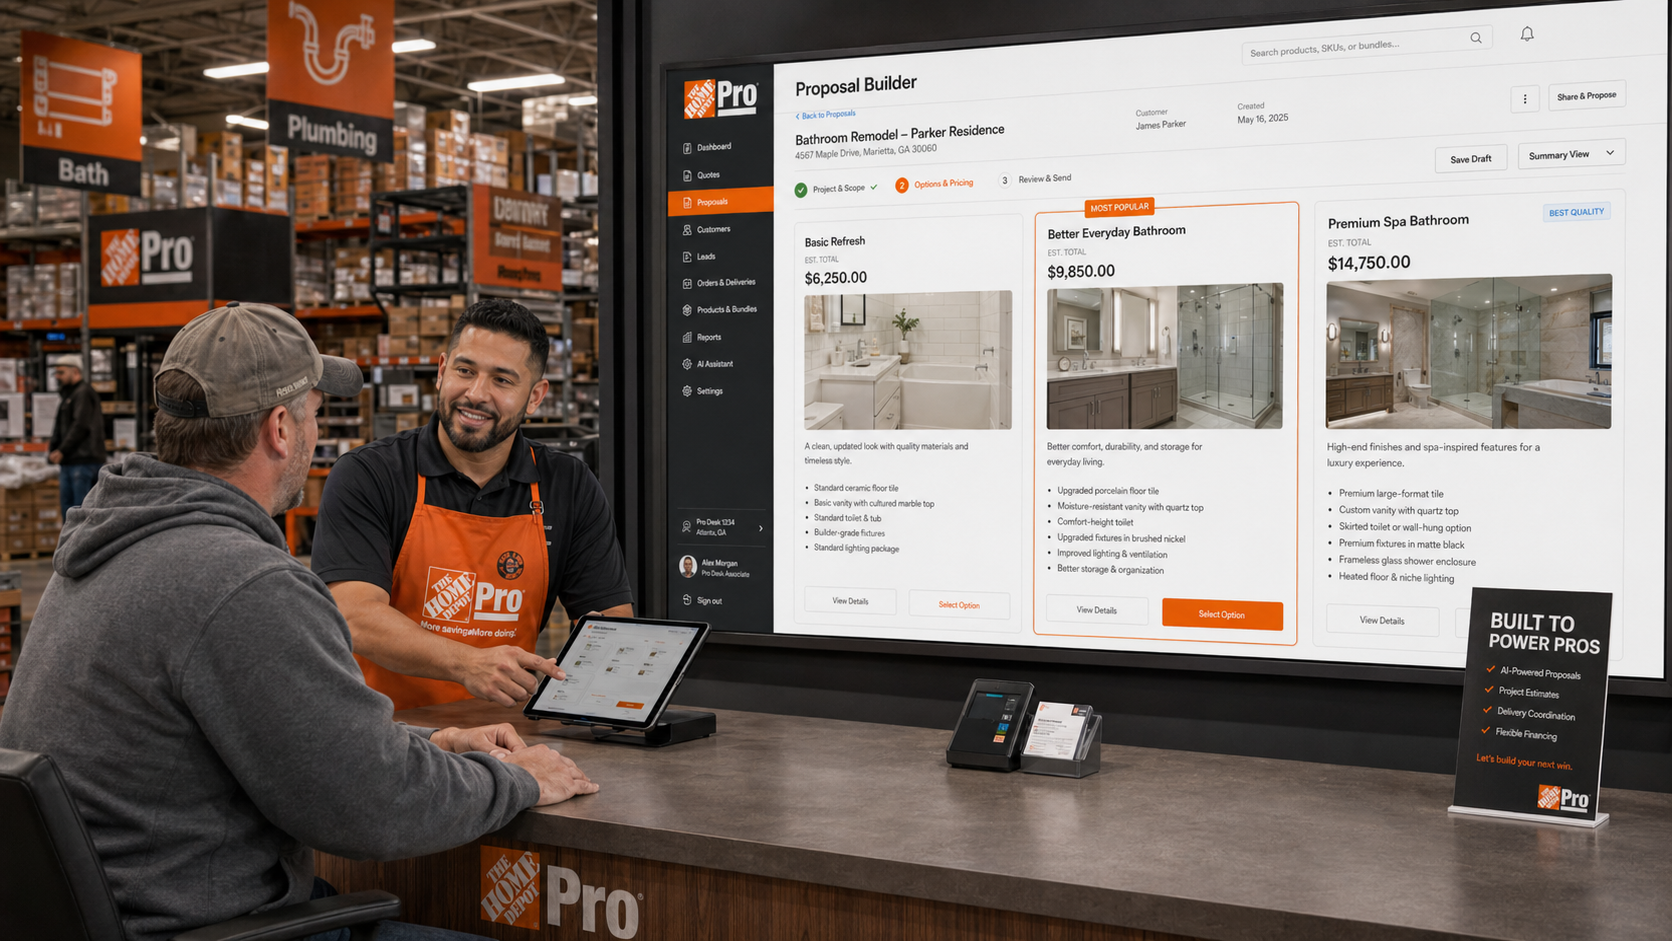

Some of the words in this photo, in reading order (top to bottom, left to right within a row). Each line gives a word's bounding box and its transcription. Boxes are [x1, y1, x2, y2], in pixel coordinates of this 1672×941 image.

[1250, 48, 1278, 57] Search
[1280, 46, 1319, 57] products,
[1321, 43, 1346, 52] SKUs,
[1358, 40, 1399, 49] bundles...
[796, 77, 859, 98] Proposal
[864, 74, 917, 91] Builder
[717, 80, 757, 107] Pro
[1557, 93, 1578, 101] Share
[1579, 92, 1585, 100] &
[1587, 92, 1617, 100] Propose
[1237, 102, 1264, 110] Created
[826, 109, 856, 118] Proposals
[1135, 109, 1168, 117] Customer
[1237, 115, 1254, 125] May
[1256, 114, 1266, 123] 16,
[1268, 112, 1288, 122] 2025
[1135, 122, 1161, 130] James
[1162, 120, 1186, 128] Parker
[288, 114, 378, 157] Plumbing
[795, 133, 847, 145] Bathroom
[851, 128, 898, 142] Remodel
[911, 127, 946, 138] Parker
[949, 124, 1004, 136] Residence
[697, 142, 731, 151] Dashboard
[795, 150, 814, 159] 4567
[815, 150, 838, 159] Maple
[840, 148, 861, 157] Drive,
[863, 147, 896, 155] Marietta,
[898, 145, 910, 154] GA
[912, 143, 937, 153] 30060
[1450, 155, 1469, 164] Save
[1471, 154, 1491, 163] Draft
[1529, 152, 1568, 160] Summary
[1569, 150, 1589, 158] View
[58, 158, 109, 187] Bath
[697, 171, 720, 179] Quotes
[1002, 176, 1008, 184] 3
[1018, 175, 1044, 183] Review
[1045, 174, 1051, 182] &
[1052, 173, 1071, 182] Send
[813, 185, 836, 194] Project
[837, 184, 843, 192] &
[844, 184, 865, 192] Scope
[899, 182, 905, 190] 2
[914, 180, 941, 190] Options
[942, 179, 948, 187] &
[949, 178, 973, 187] Pricing
[697, 197, 728, 207] Proposals
[1091, 204, 1112, 212] MOST
[1114, 202, 1149, 211] POPULAR
[1549, 208, 1569, 217] BEST
[1570, 207, 1604, 216] QUALITY
[1328, 217, 1380, 229] Premium
[1383, 216, 1406, 229] Spa
[1410, 214, 1469, 226] Bathroom
[1048, 229, 1079, 239] Better
[1082, 226, 1130, 240] Everyday
[1133, 225, 1186, 236] Bathroom
[805, 237, 828, 247] Basic
[831, 235, 865, 246] Refresh
[1328, 239, 1344, 247] EST.
[1346, 238, 1371, 246] TOTAL
[141, 230, 193, 272] Pro
[697, 252, 715, 260] Leads
[1047, 248, 1062, 257] EST.
[1063, 248, 1086, 256] TOTAL
[804, 256, 818, 264] EST.
[819, 255, 839, 263] TOTAL
[1328, 254, 1410, 272] $14,750.00
[805, 270, 867, 286] $6,250.00
[1047, 264, 1115, 280] $9,850.00
[697, 279, 718, 287] Orders
[718, 278, 724, 286] &
[725, 278, 756, 286] Deliveries
[725, 305, 731, 313] &
[732, 305, 757, 313] Bundles
[697, 333, 721, 342] Reports
[697, 387, 723, 396] Settings
[1327, 442, 1367, 453] High-end
[1369, 442, 1402, 451] finishes
[1404, 442, 1421, 451] and
[1423, 442, 1478, 453] spa-inspired
[1480, 442, 1517, 451] features
[1519, 442, 1532, 451] for
[1327, 458, 1353, 469] luxury
[1354, 458, 1404, 469] experience.
[1339, 488, 1375, 497] Premium
[1376, 489, 1429, 500] large-format
[1431, 489, 1444, 498] tile
[1057, 501, 1123, 510] Moisture-resistant
[1124, 503, 1146, 512] vanity
[1148, 502, 1164, 511] with
[1165, 504, 1189, 513] quartz
[1190, 504, 1204, 513] top
[814, 513, 844, 521] Standard
[844, 514, 862, 522] toilet
[863, 514, 868, 522] &
[870, 514, 882, 522] tub
[1057, 516, 1114, 528] Comfort-height
[1115, 518, 1133, 526] toilet
[1339, 554, 1380, 564] Frameless
[1381, 556, 1402, 566] glass
[1404, 556, 1434, 565] shower
[1435, 557, 1476, 566] enclosure
[1057, 563, 1080, 572] Better
[1081, 566, 1109, 575] storage
[1110, 564, 1116, 573] &
[1118, 566, 1164, 576] organization
[425, 572, 475, 618] HOME
[475, 582, 523, 612] Pro
[697, 596, 711, 606] Sign
[442, 591, 472, 620] DEPOT
[1198, 609, 1220, 618] Select
[1221, 610, 1245, 620] Option
[1359, 615, 1378, 624] View
[1379, 616, 1405, 625] Details
[1491, 612, 1544, 630] BUILT
[1548, 615, 1574, 632] TO
[1489, 633, 1549, 651] POWER
[1554, 637, 1600, 654] PROS
[1500, 666, 1544, 677] AI-Powered
[1545, 669, 1581, 680] Proposals
[1499, 686, 1524, 697] Project
[1525, 688, 1559, 699] Estimates
[1497, 706, 1527, 718] Delivery
[1528, 709, 1575, 721] Coordination
[1496, 727, 1522, 737] Flexible
[1524, 730, 1557, 742] Financing
[1476, 753, 1494, 763] Let's
[1496, 755, 1516, 765] build
[1517, 759, 1535, 767] your
[1556, 761, 1572, 770] win.
[1561, 788, 1589, 808] Pro
[486, 854, 511, 884] THE
[481, 851, 540, 922] HOME
[504, 882, 540, 925] DEPOT
[547, 865, 639, 939] Pro
